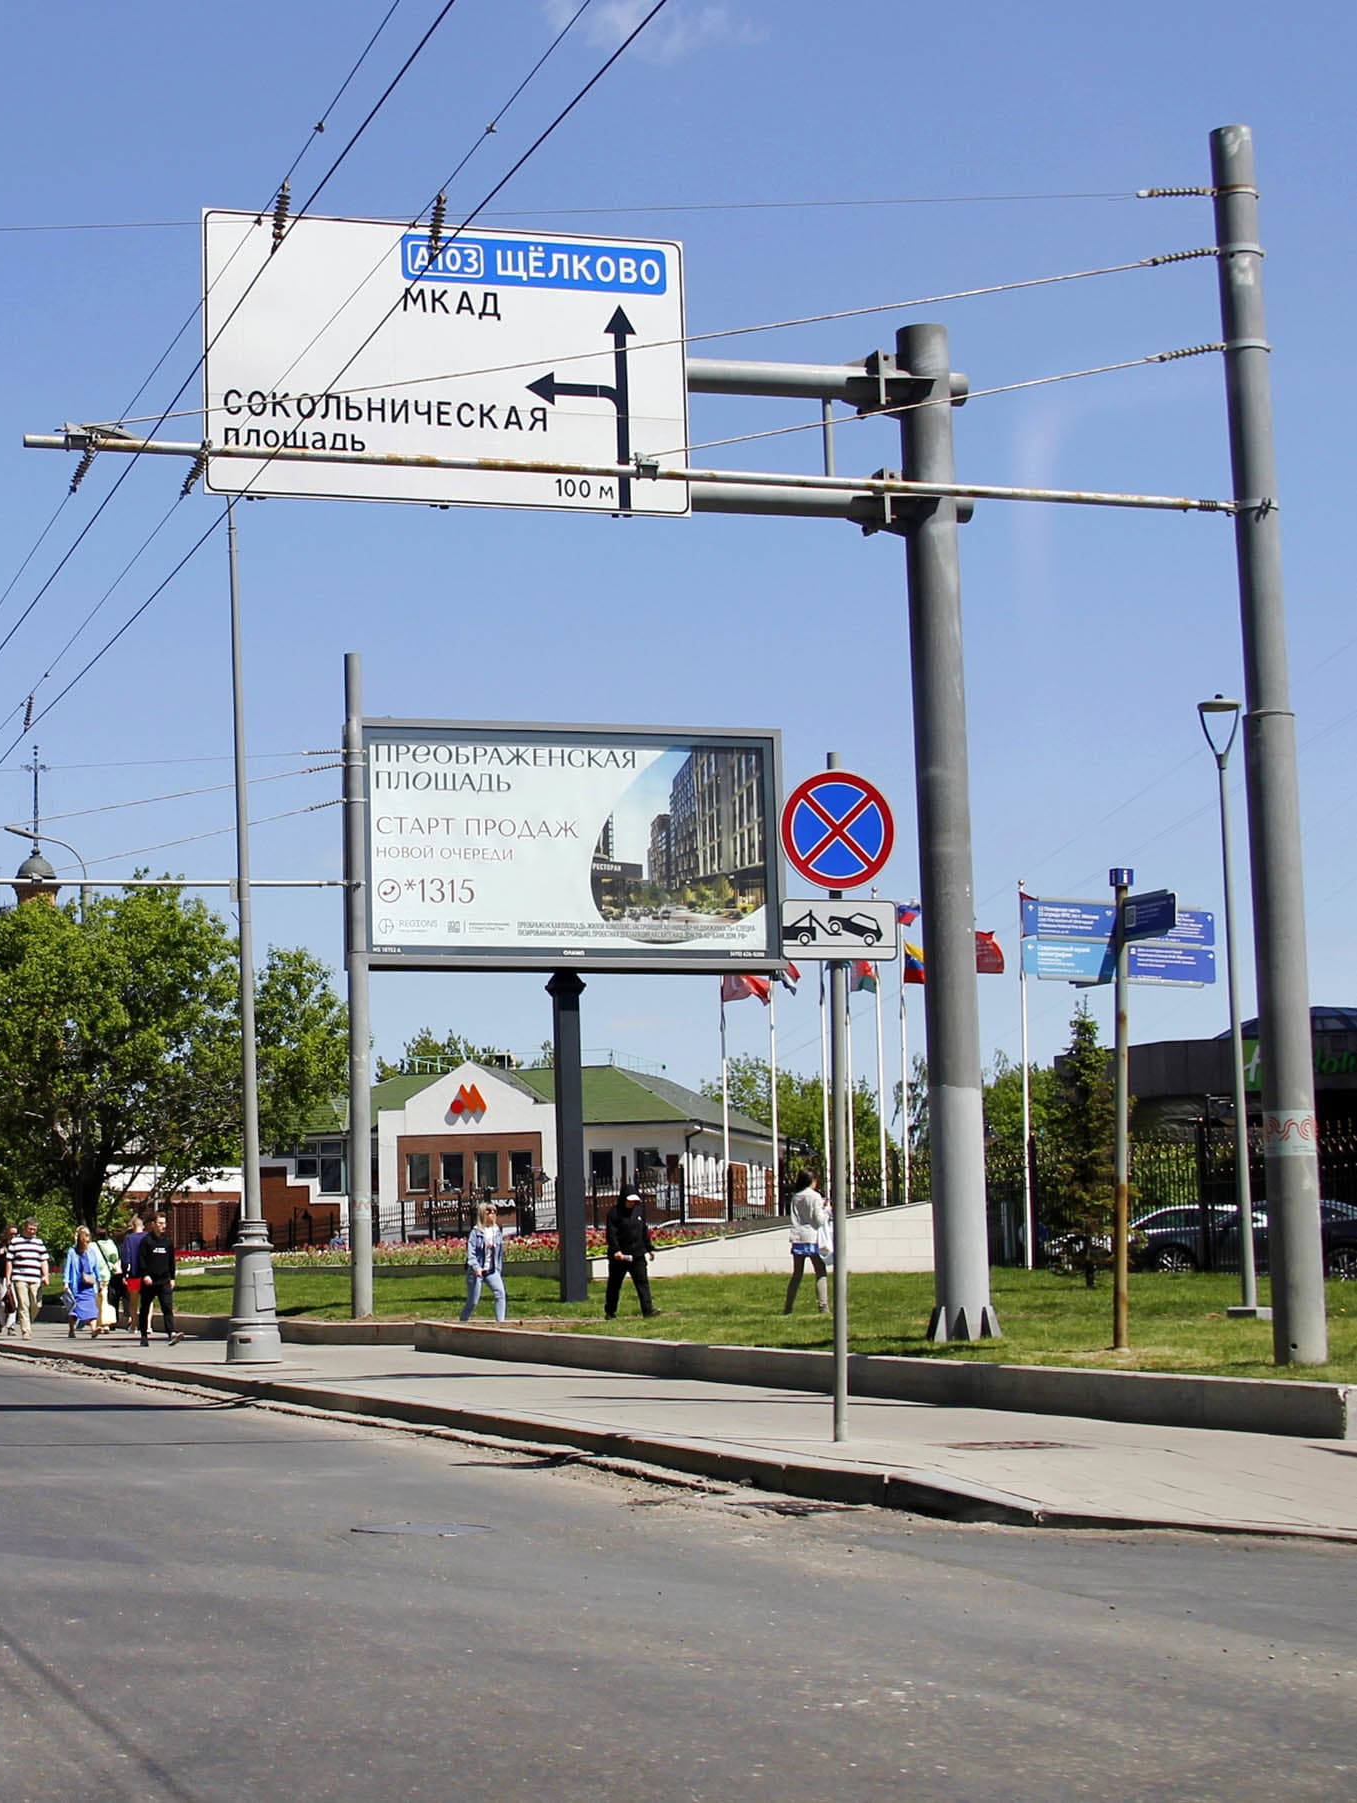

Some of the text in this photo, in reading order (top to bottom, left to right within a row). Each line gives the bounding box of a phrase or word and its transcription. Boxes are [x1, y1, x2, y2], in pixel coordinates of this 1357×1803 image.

[496, 246, 661, 286] ЩЁЛКОВО
[402, 287, 502, 321] МКАД
[223, 389, 548, 432] СОКОЛЬНИЧЕСКАЯ
[223, 427, 367, 452] площадь
[554, 478, 591, 499] 100
[374, 770, 512, 794] ПЛОЩАДЬ
[376, 815, 579, 839] СТАРТ ПРОДАЖ
[375, 844, 514, 862] НОВОЙ ОЧЕРЕДИ
[398, 919, 438, 929] REGIONS
